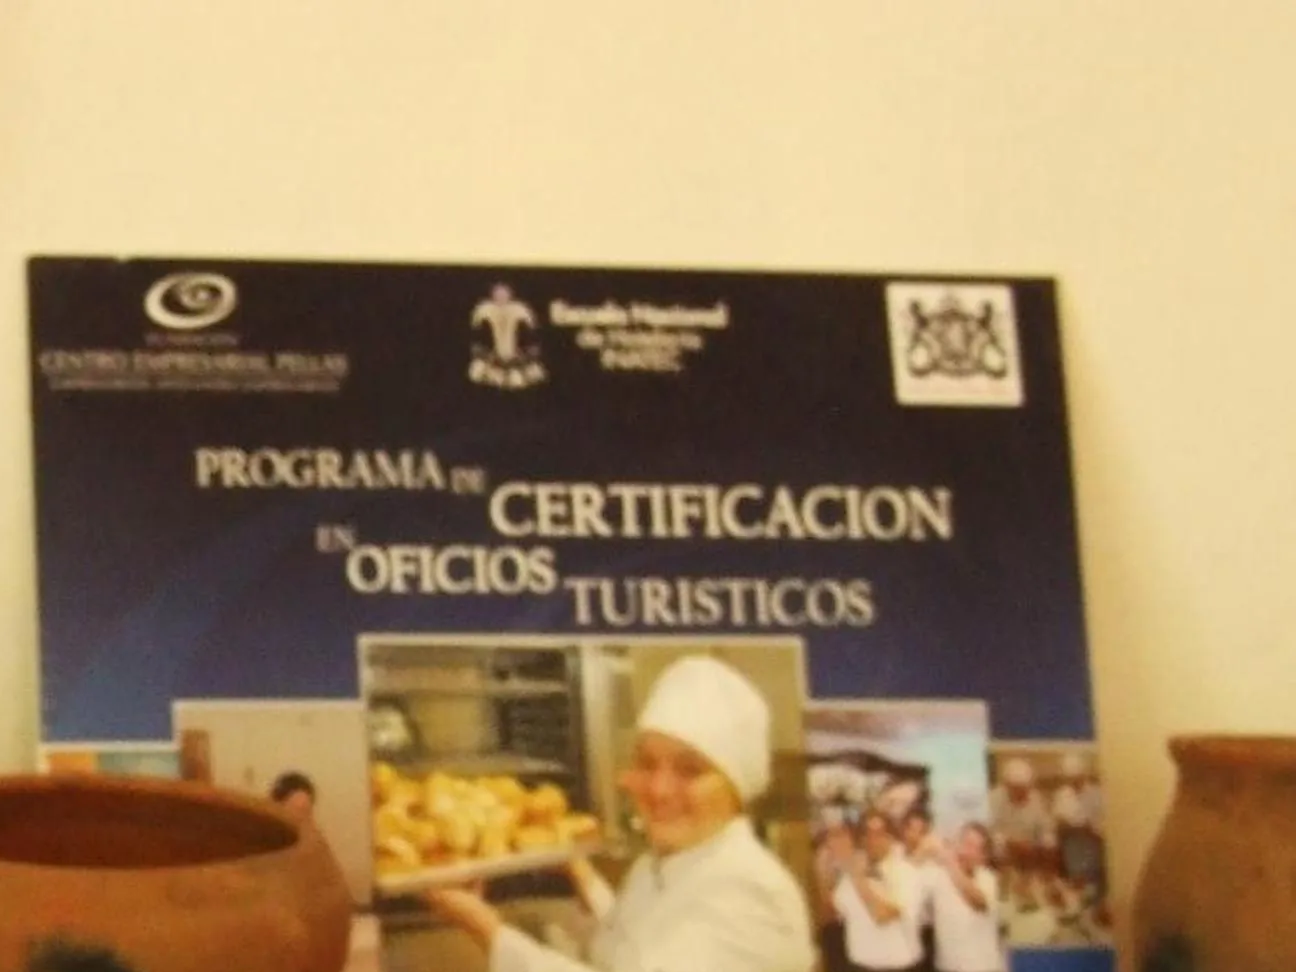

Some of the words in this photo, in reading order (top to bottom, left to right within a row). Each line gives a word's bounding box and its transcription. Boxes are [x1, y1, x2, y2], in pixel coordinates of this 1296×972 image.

[195, 447, 445, 489] PROGRAMA
[489, 482, 953, 540] CERTIFICACION
[315, 525, 355, 551] EN
[346, 544, 557, 594] OFICIOS
[564, 576, 875, 627] TURISTICOS
